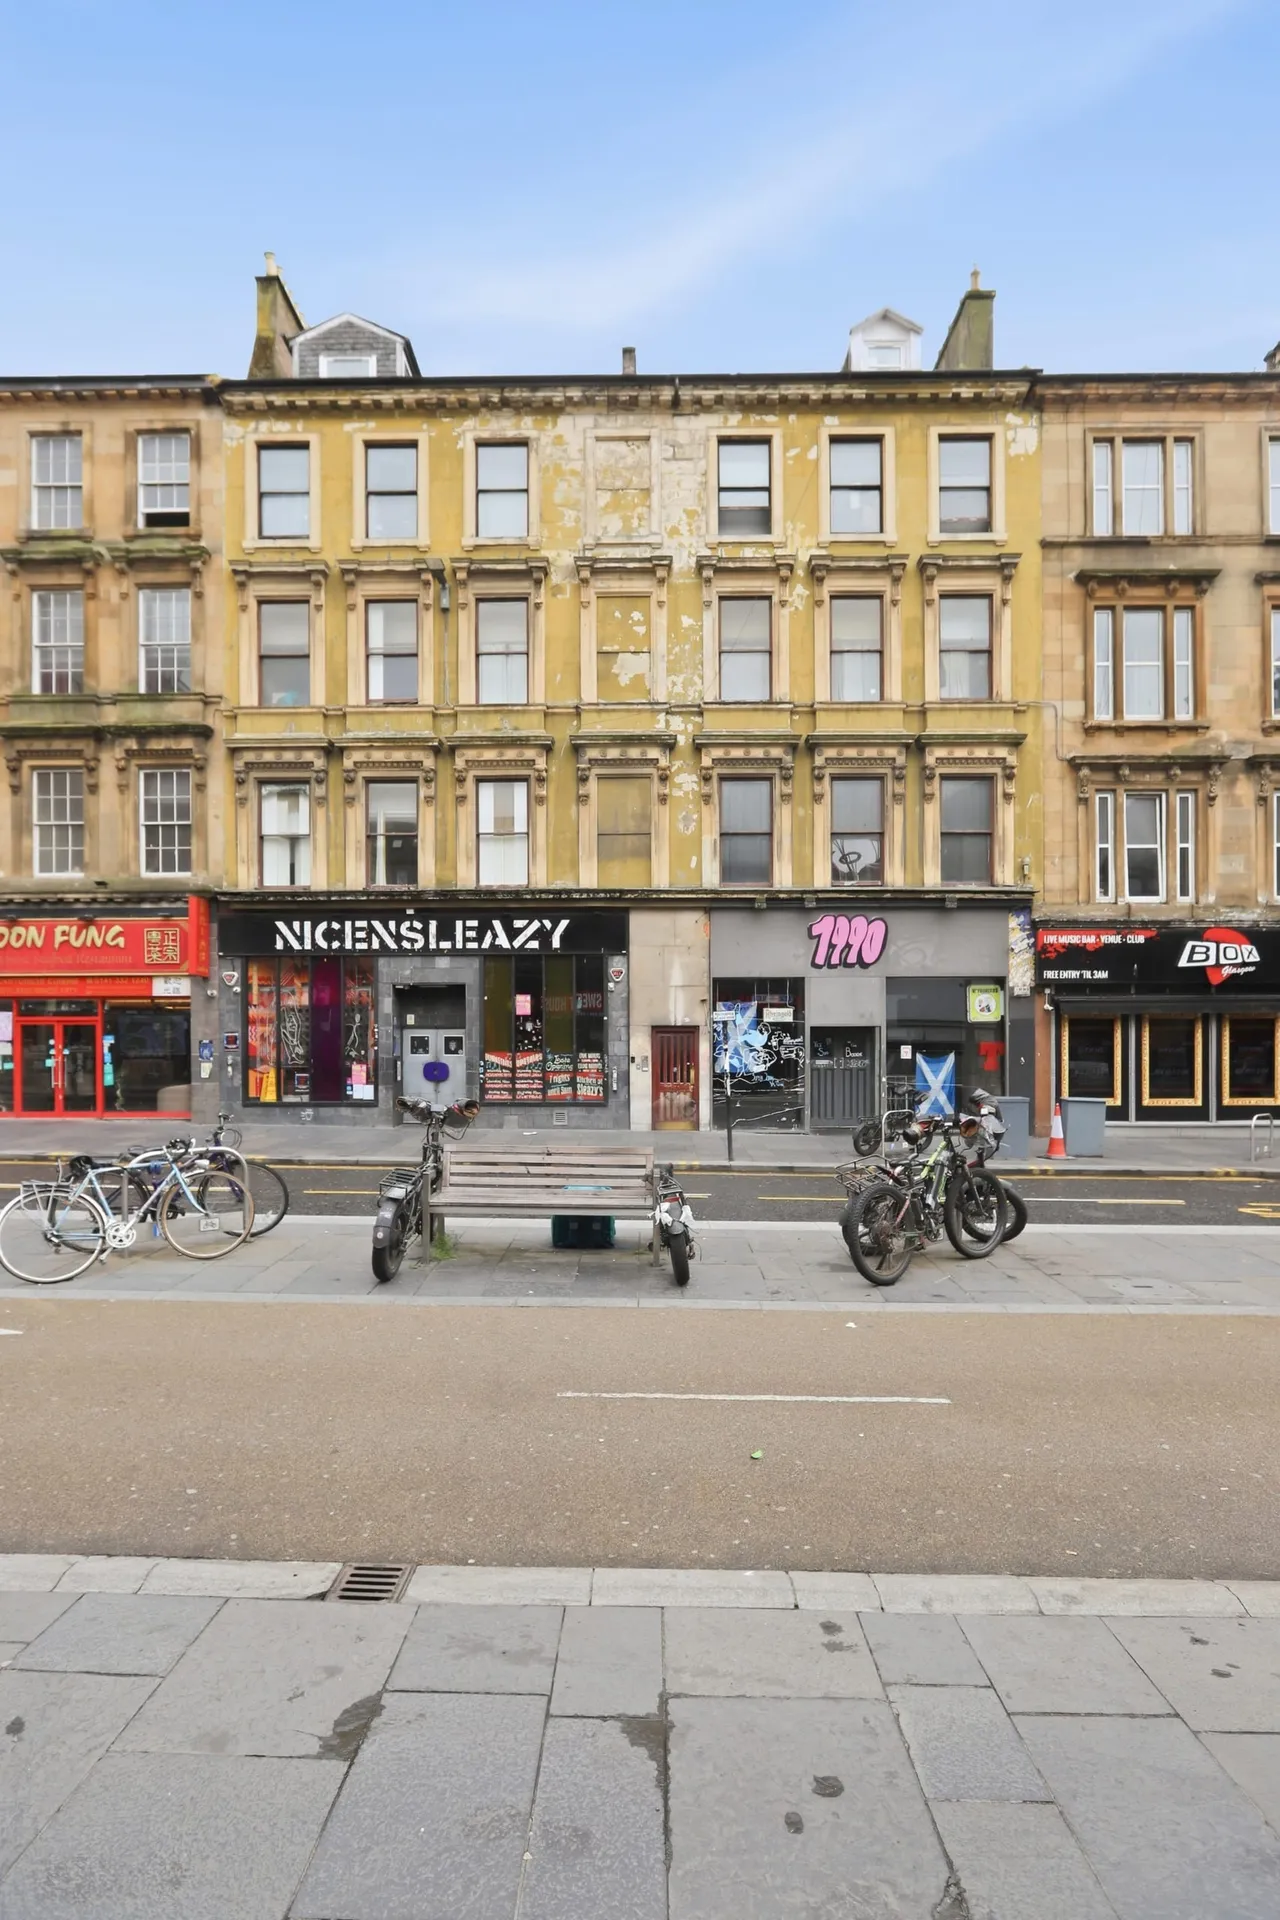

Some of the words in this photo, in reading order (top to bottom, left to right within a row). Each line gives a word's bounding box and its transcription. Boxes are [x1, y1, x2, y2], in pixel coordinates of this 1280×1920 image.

[53, 924, 126, 951] FUNG
[808, 913, 888, 969] 1990
[1043, 934, 1058, 944] LIVE
[1058, 934, 1081, 944] MUSIC
[1081, 934, 1096, 944] BAR
[1100, 934, 1122, 944] VENUE
[1126, 934, 1145, 944] CLUB
[1184, 943, 1259, 965] BOX
[1043, 970, 1059, 979] FREE
[1059, 970, 1080, 979] ENTRY
[1092, 970, 1109, 979] 3AM
[1221, 965, 1256, 978] Glasgow
